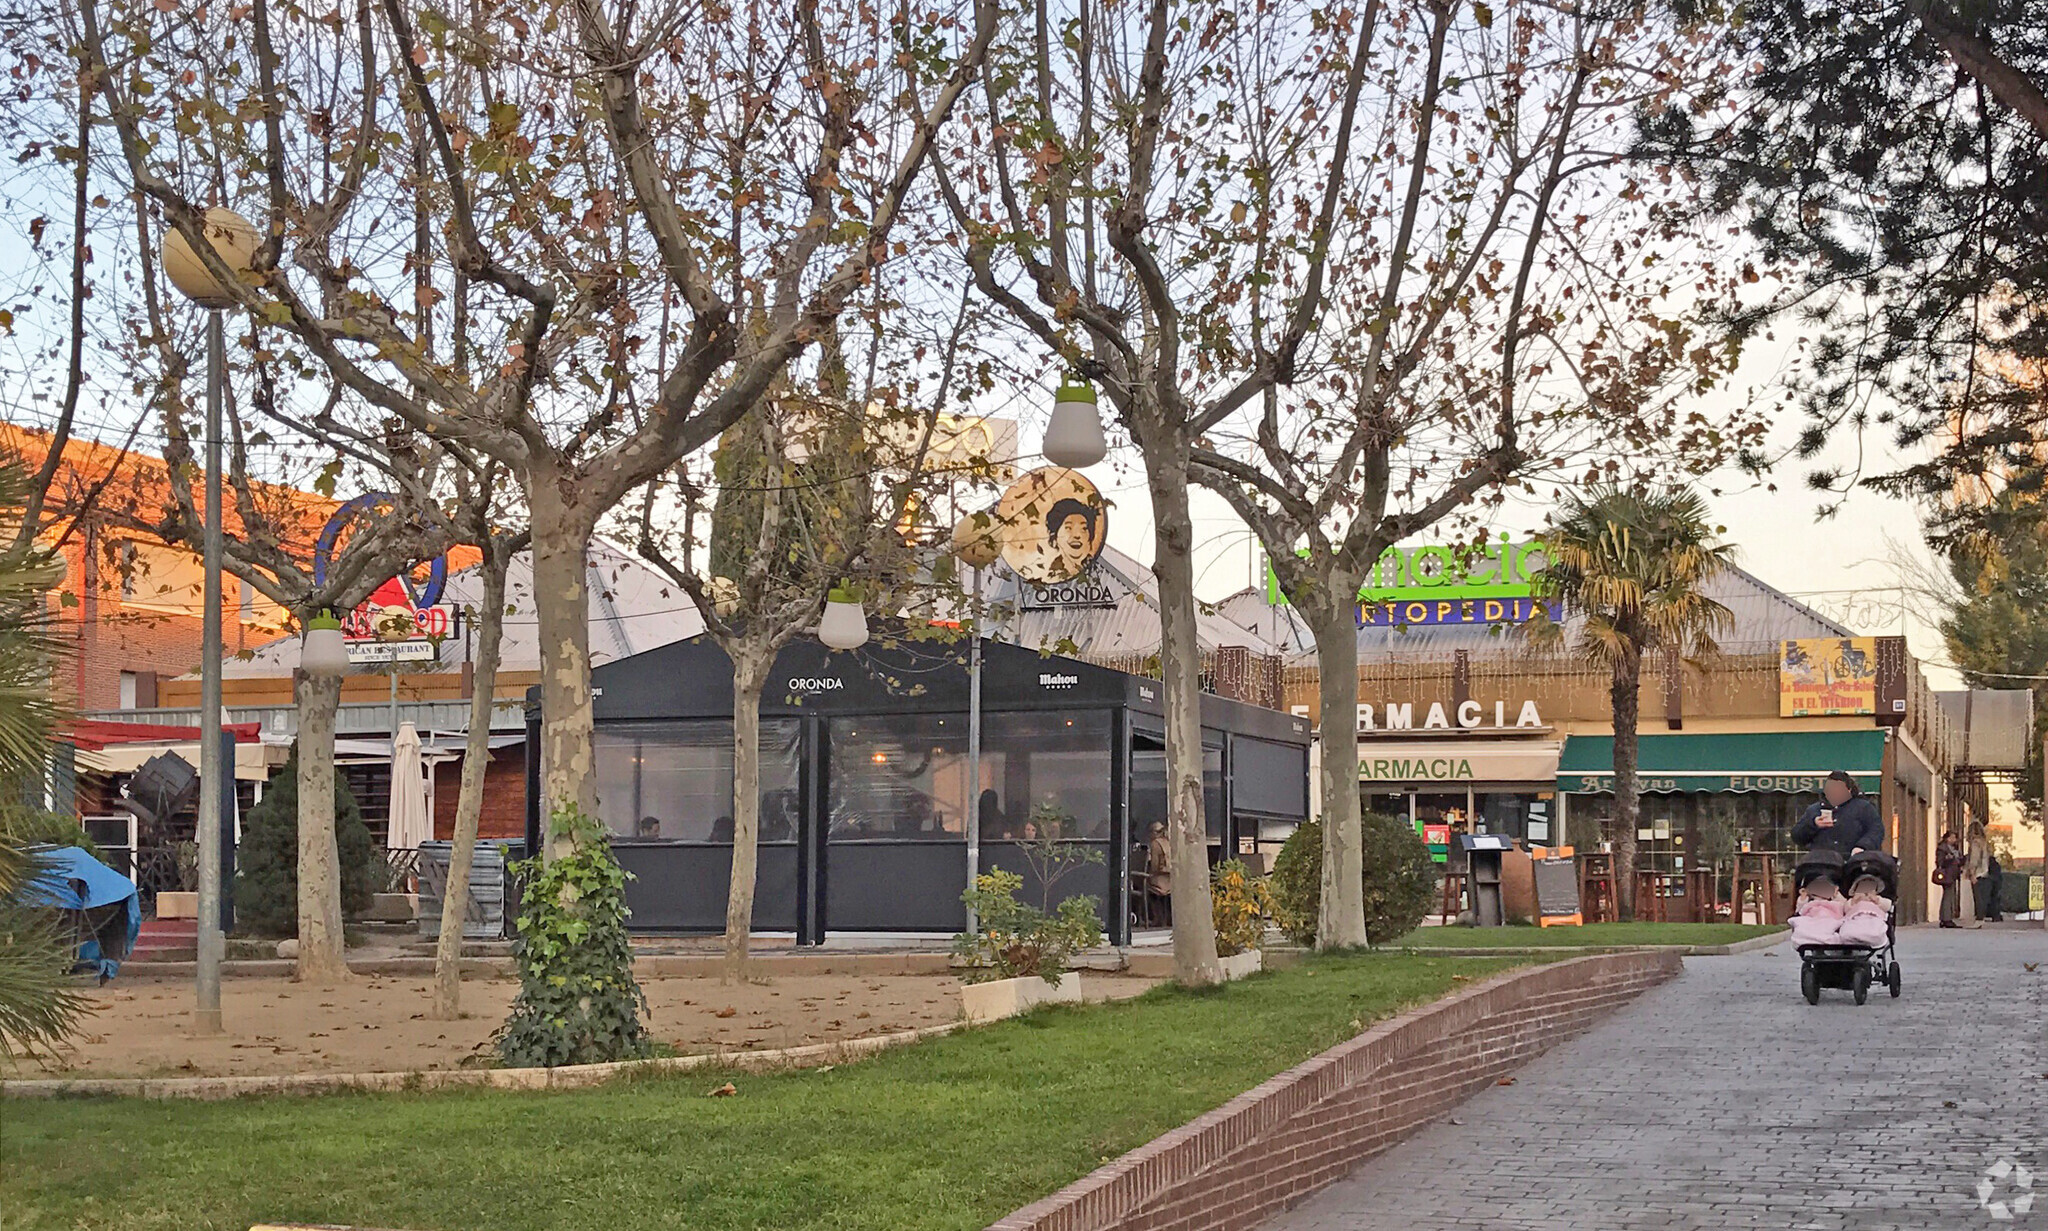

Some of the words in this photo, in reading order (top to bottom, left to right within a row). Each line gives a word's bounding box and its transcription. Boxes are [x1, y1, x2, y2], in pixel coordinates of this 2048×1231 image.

[1035, 587, 1113, 602] ORONDA
[1359, 600, 1550, 624] RTOPEDIA
[788, 678, 843, 690] ORONDA
[1040, 674, 1077, 685] Mahou
[1291, 700, 1543, 730] FRMACIA
[1358, 759, 1474, 779] ARMACIA
[1730, 777, 1828, 789] FLORIST
